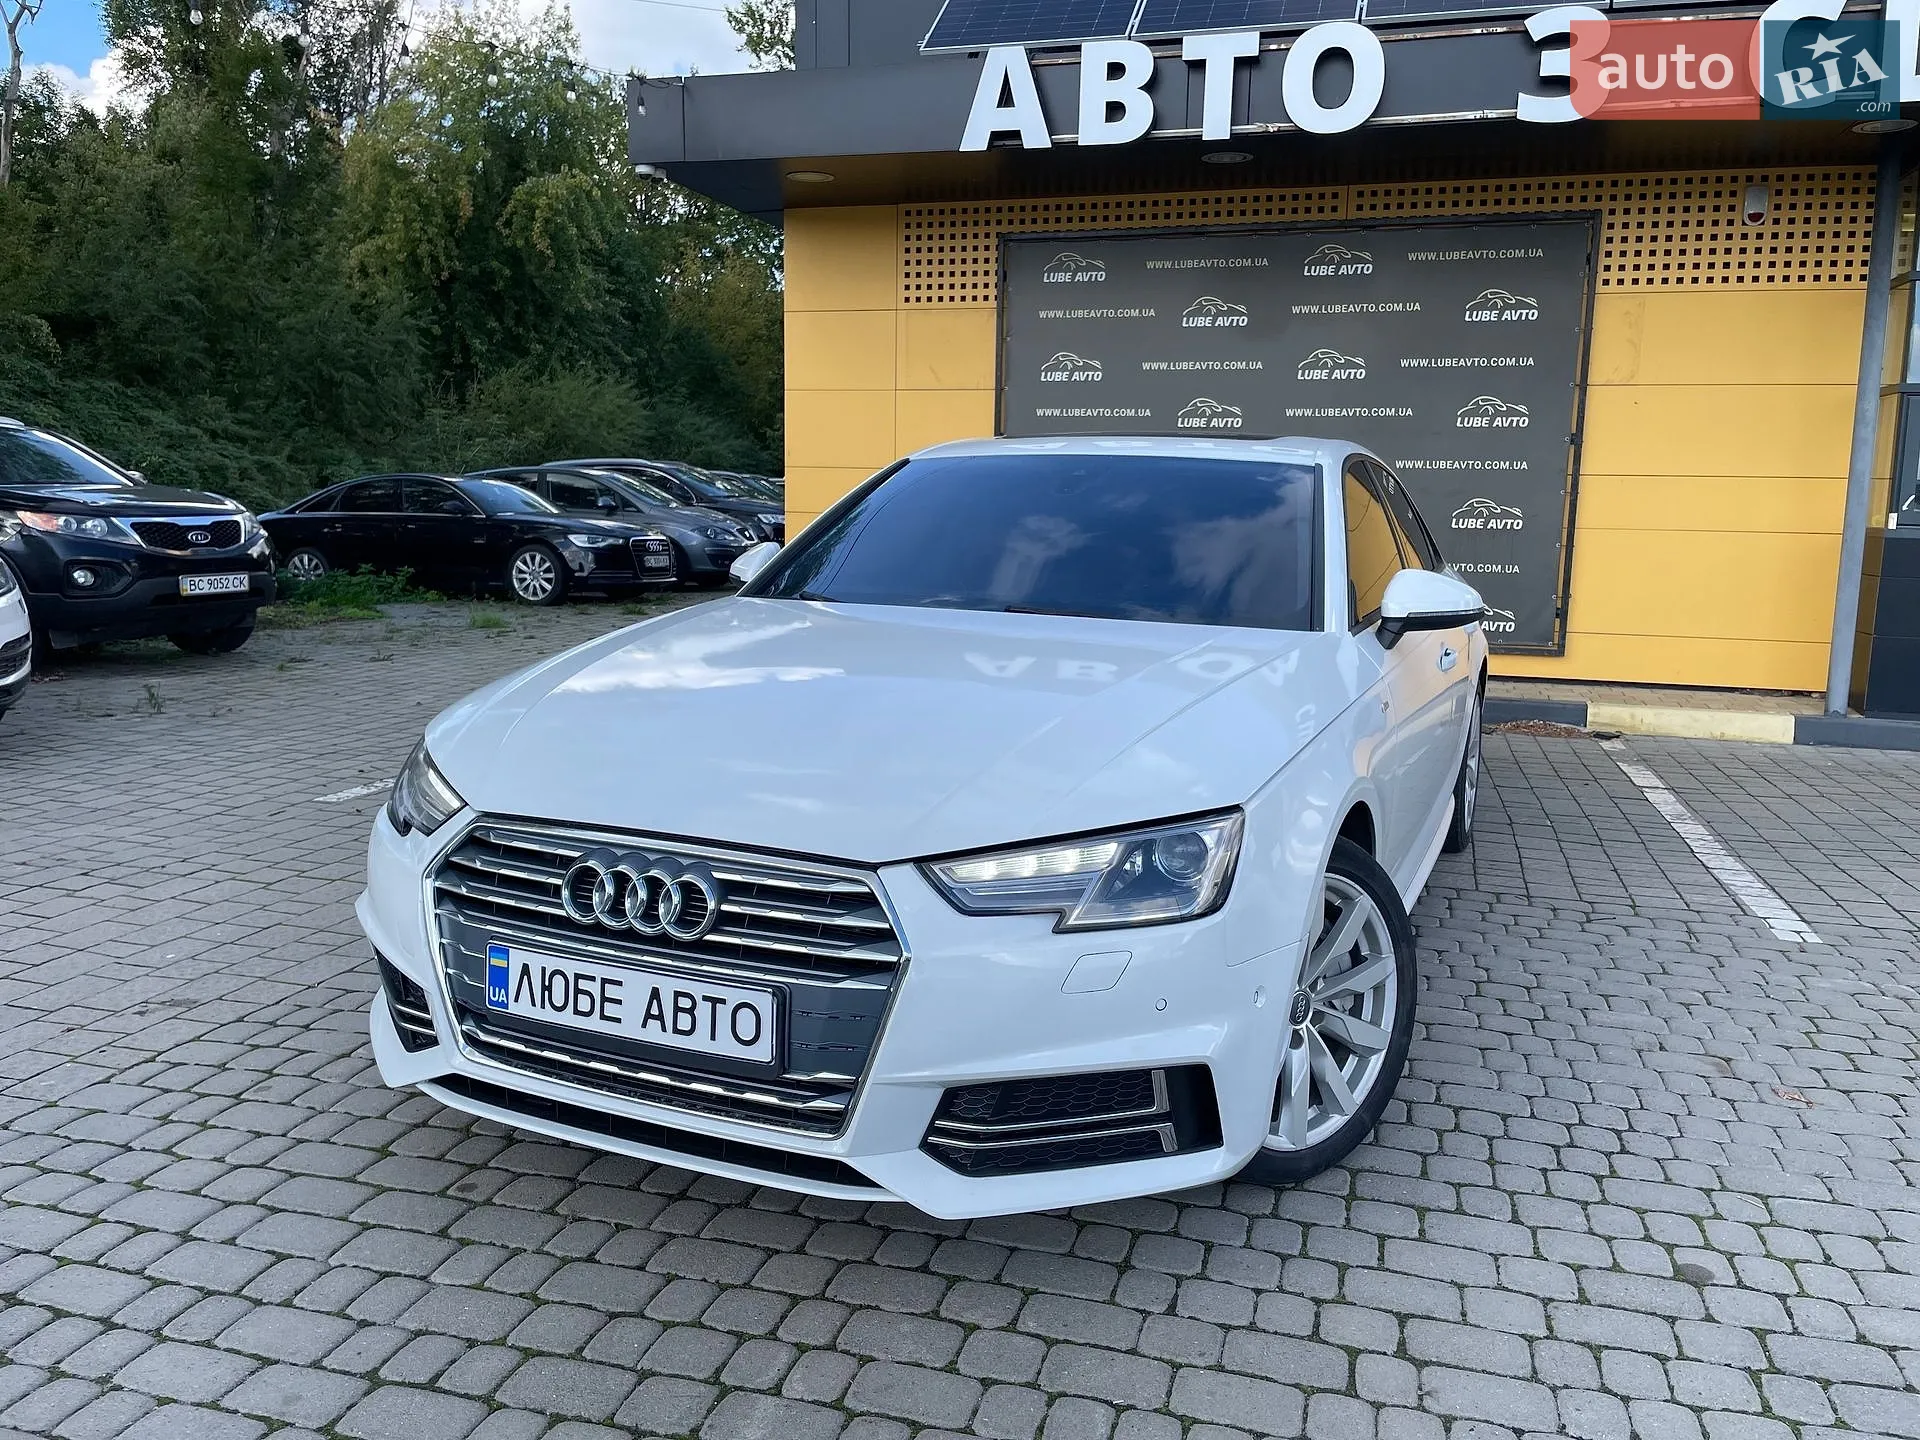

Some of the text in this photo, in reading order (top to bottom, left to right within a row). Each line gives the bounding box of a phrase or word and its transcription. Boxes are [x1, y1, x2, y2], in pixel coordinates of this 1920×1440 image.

[958, 21, 1387, 152] АВТО
[1407, 248, 1544, 261] WWW.LUBEAVTO.COM.UA
[1146, 257, 1269, 269] WWW.LUBEAVTO.COM.UA
[1303, 263, 1373, 276] LUBE AVTO
[1043, 270, 1106, 283] LUBE AVTO
[1039, 308, 1156, 319] WWW.LUBEAVTO.COM.UA
[1291, 302, 1421, 314] WWW.LUBEAVTO.COM.UA
[1182, 315, 1248, 327] LUBE AVTO
[1464, 309, 1539, 322] LUBE AVTO
[1142, 361, 1263, 371] WWW.LUBEAVTO.COM.UA
[1400, 356, 1535, 368] WWW.LUBEAVTO.COM.UA
[1040, 370, 1103, 382] LUBE AVTO
[1297, 368, 1366, 380] LUBE AVTO
[1036, 408, 1152, 418] WWW.LUBEAVTO.COM.UA
[1285, 407, 1414, 418] WWW.LUBEAVTO.COM.UA
[1177, 416, 1243, 428] LUBE AVTO
[1456, 416, 1529, 428] LUBE AVTO
[1395, 460, 1529, 470] WWW.LUBEAVTO.COM.UA
[1451, 518, 1523, 530] LUBE AVTO
[1448, 563, 1520, 574] VTO.COM.UA
[207, 577, 230, 592] 9052
[1480, 620, 1516, 633] AVTO
[489, 985, 508, 1005] UA
[513, 962, 762, 1047] ЛЮБЕ АВТО
